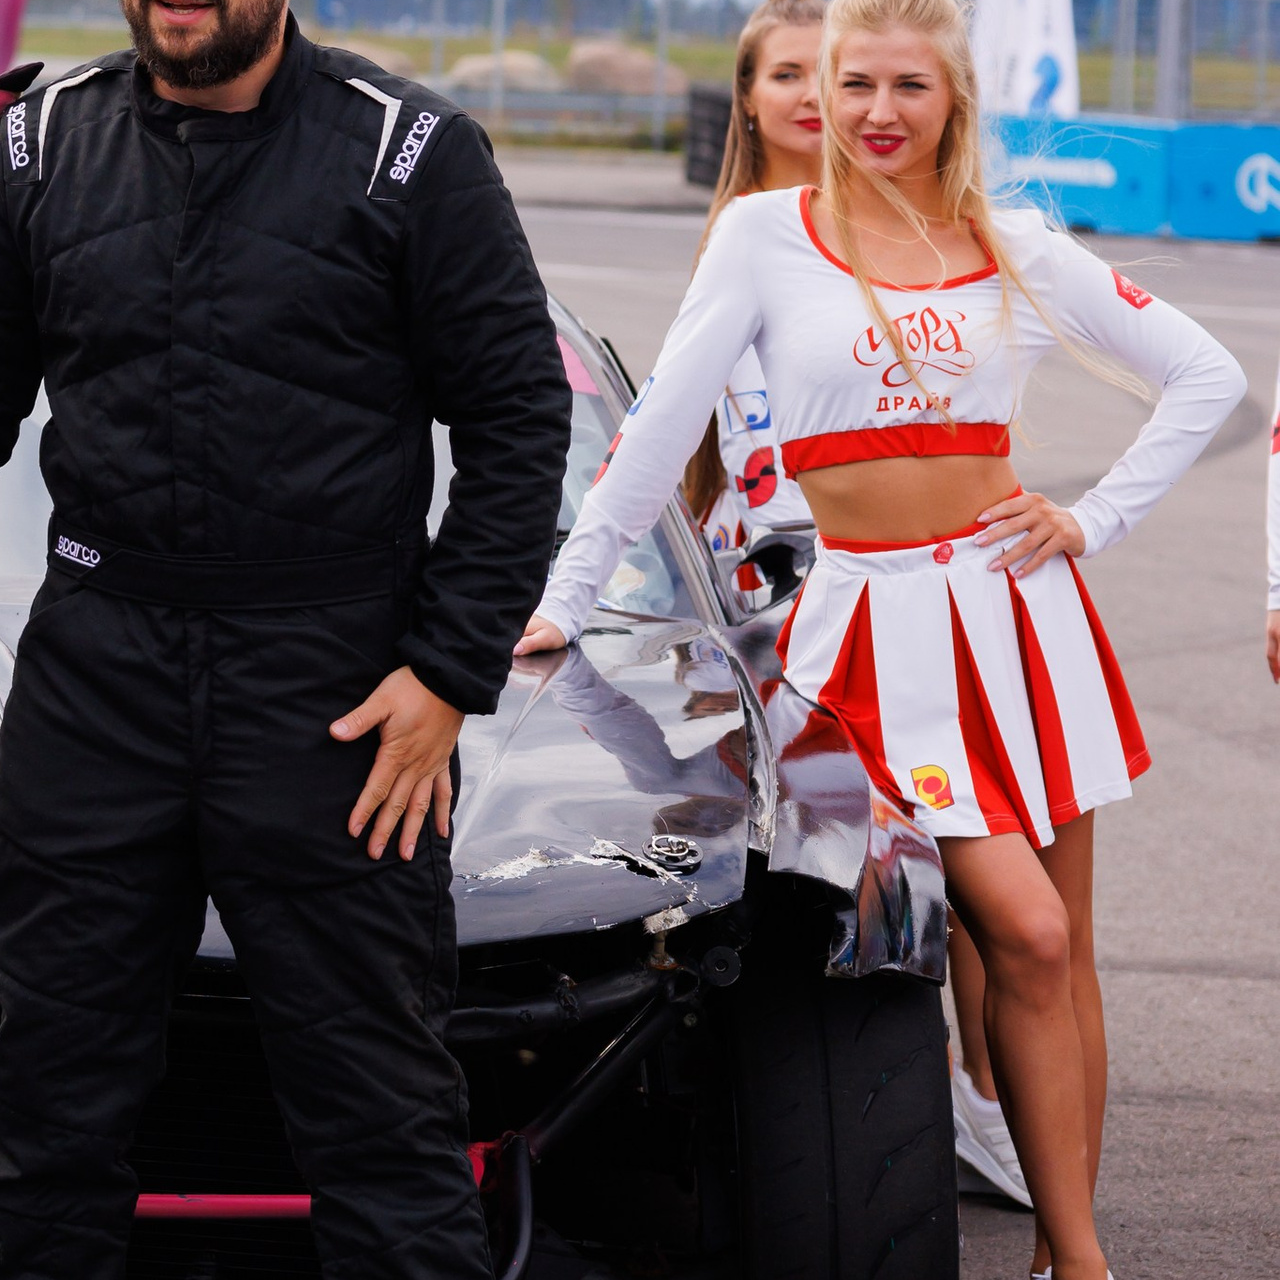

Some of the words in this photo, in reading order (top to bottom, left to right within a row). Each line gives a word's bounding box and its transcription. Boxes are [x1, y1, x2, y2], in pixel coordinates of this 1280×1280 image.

[7, 102, 29, 168] sparco
[390, 112, 437, 183] sparco
[56, 535, 101, 566] sparco
